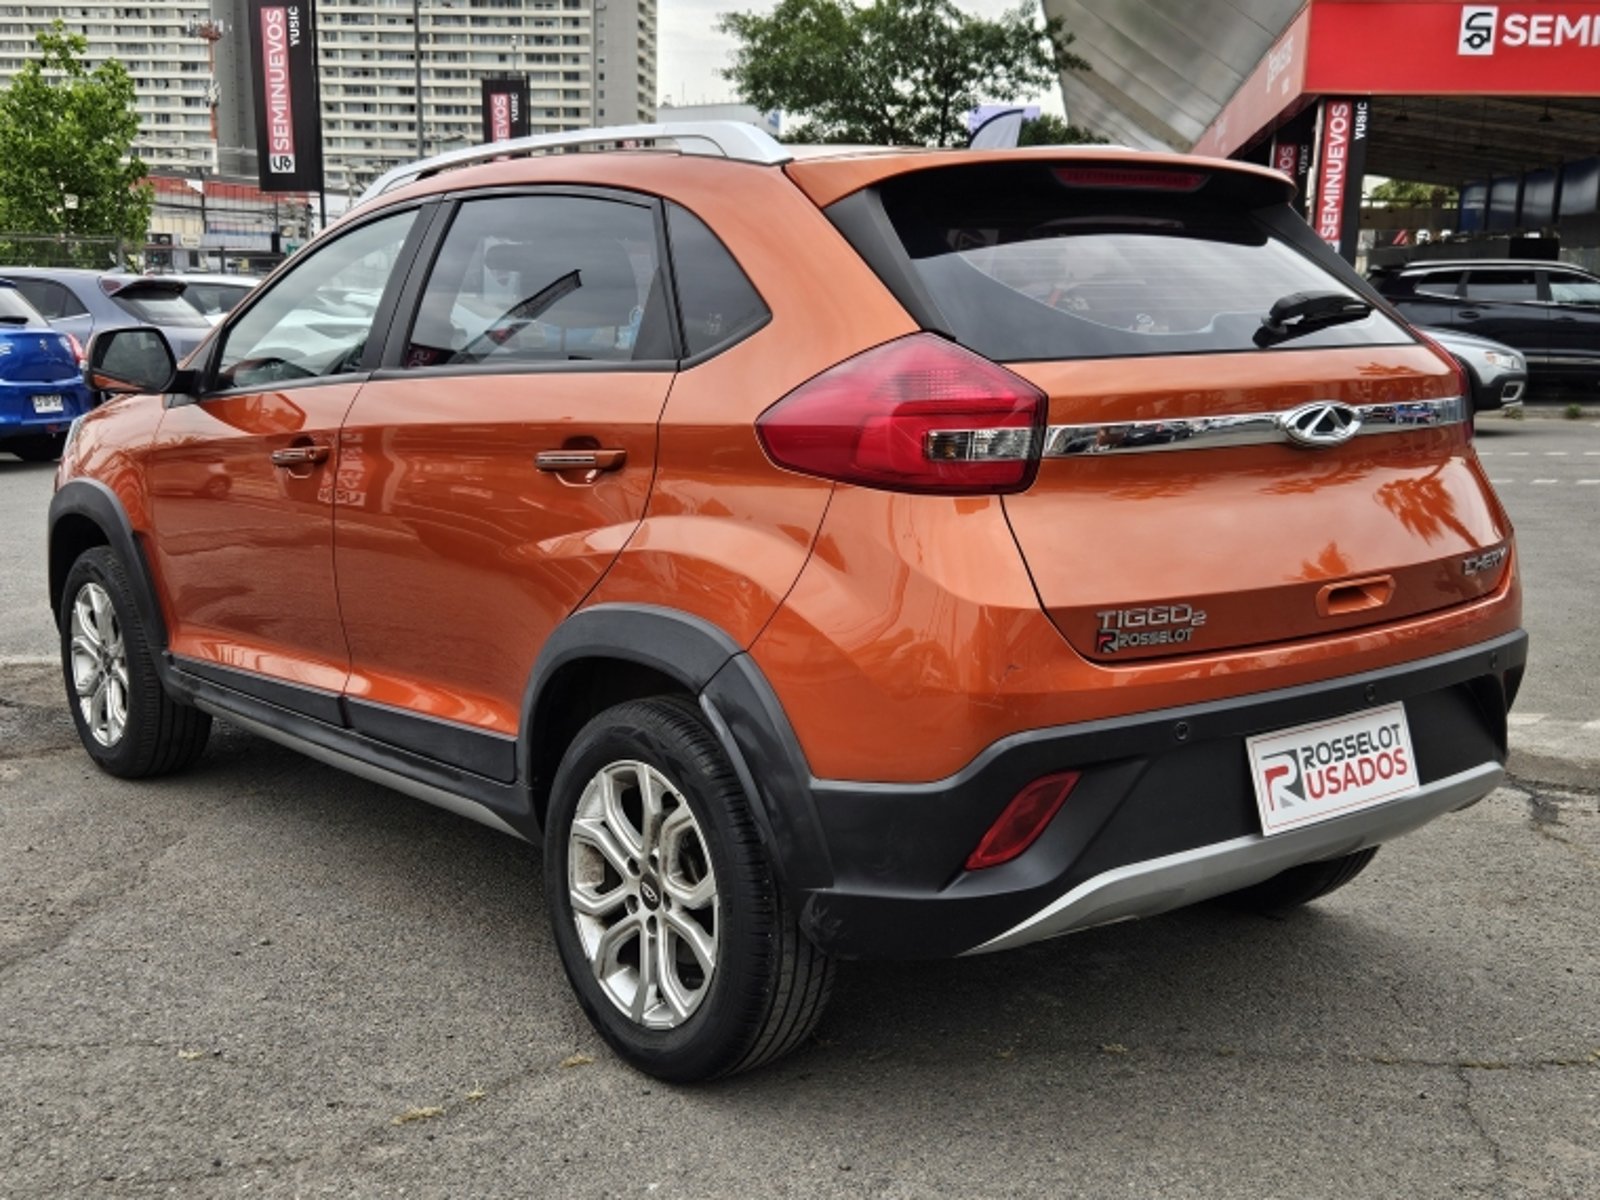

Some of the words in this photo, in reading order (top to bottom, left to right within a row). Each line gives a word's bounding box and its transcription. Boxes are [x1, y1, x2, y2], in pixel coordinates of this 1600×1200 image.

[266, 9, 290, 151] SEMINUEVOS
[1320, 103, 1349, 239] SEMINUEVOS
[1463, 547, 1507, 576] CHERY
[1118, 627, 1194, 647] ROSSELOT
[1301, 723, 1401, 771] ROSSELOT
[1305, 748, 1408, 801] USADOS
